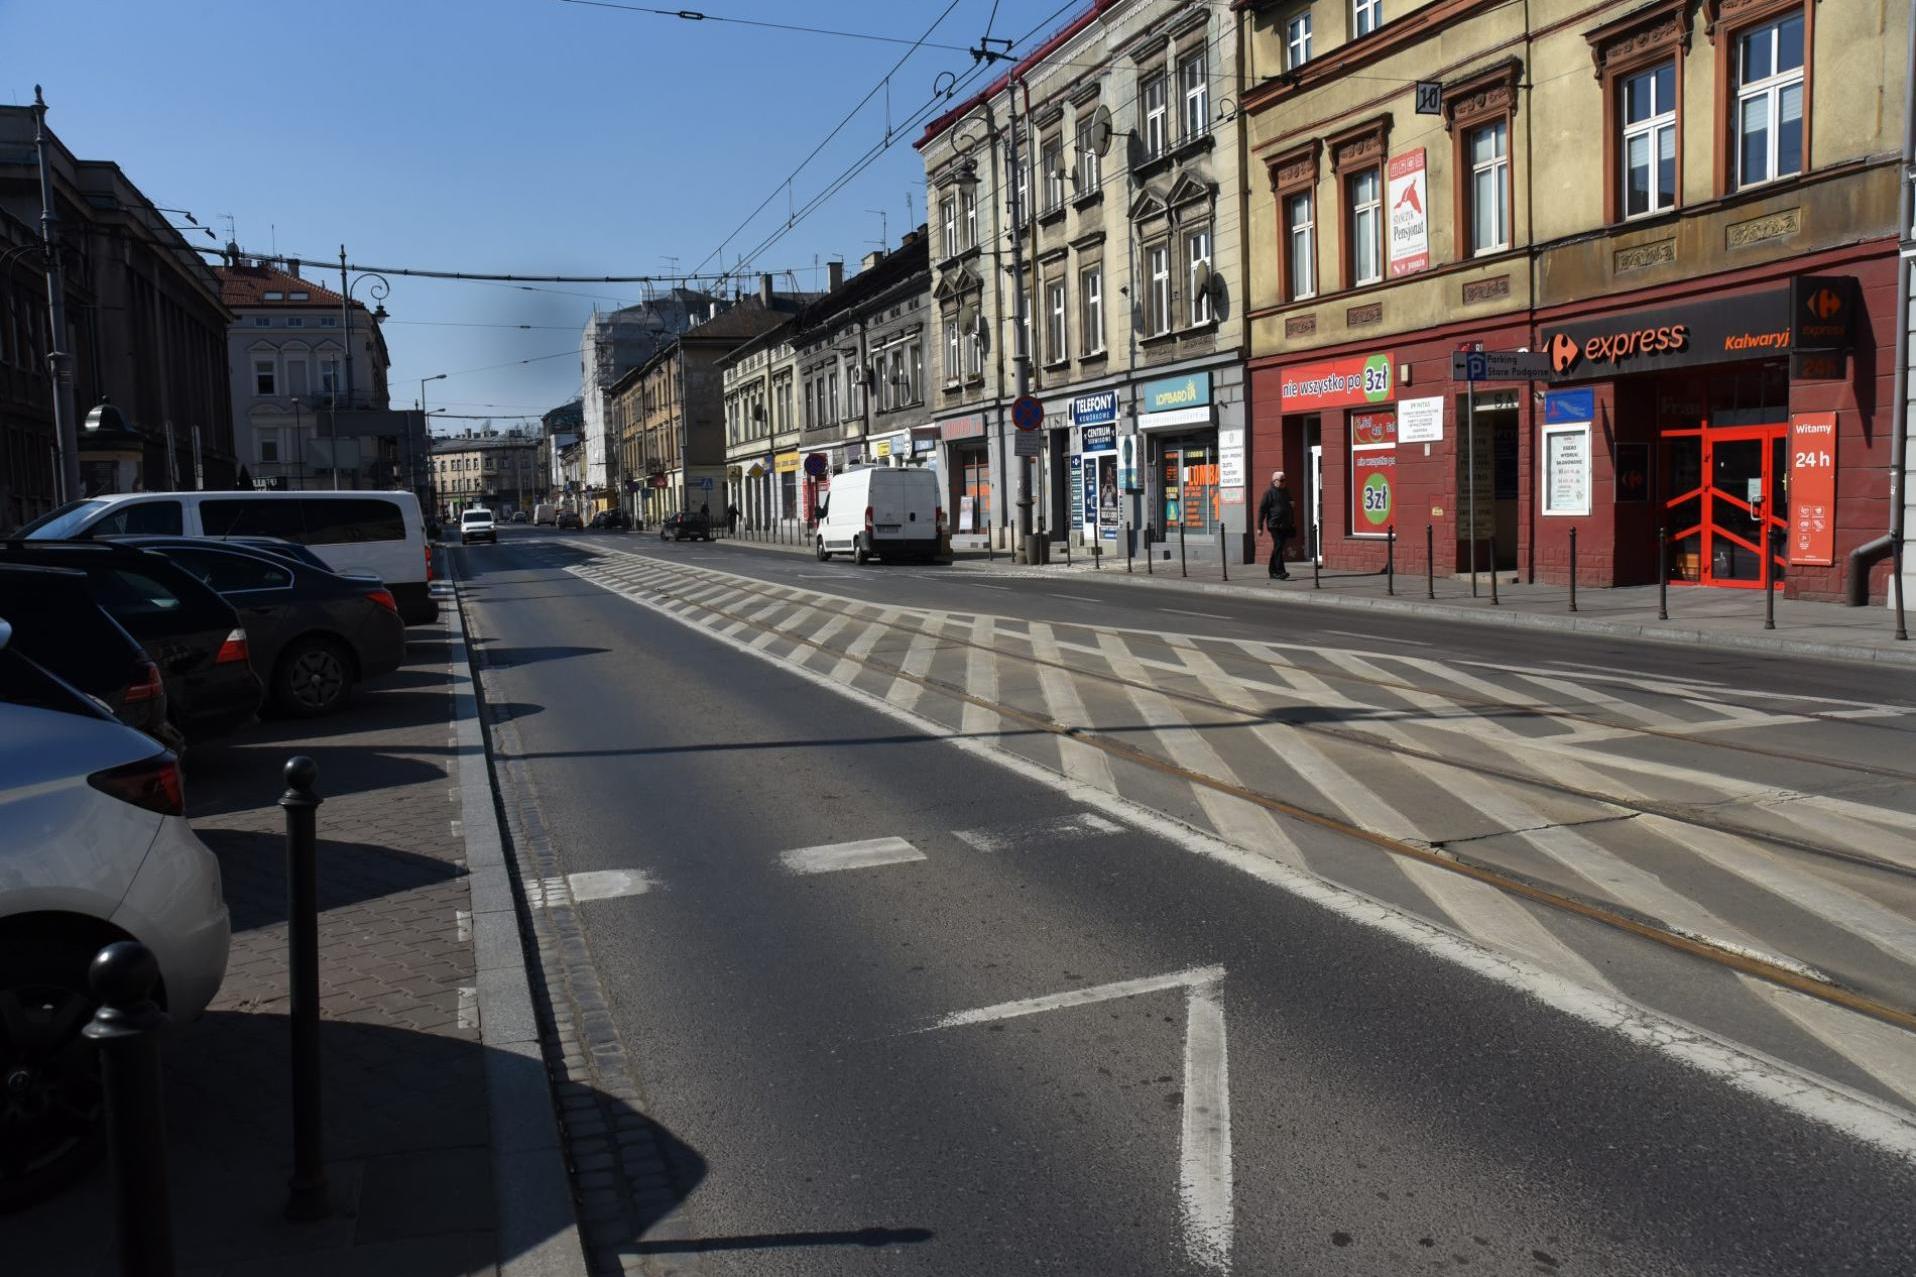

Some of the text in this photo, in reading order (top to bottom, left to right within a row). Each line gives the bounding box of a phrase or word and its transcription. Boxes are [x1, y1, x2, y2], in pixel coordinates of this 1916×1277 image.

[1393, 221, 1424, 241] Pensjonat
[1585, 325, 1686, 364] express
[1724, 328, 1791, 350] Kalwaryj
[1488, 354, 1518, 365] Parking
[1282, 363, 1389, 398] nie wszystko po 3zł
[1488, 367, 1509, 377] Stare
[1076, 394, 1113, 414] TELEFONY
[1087, 426, 1111, 438] CENTRUM
[1795, 424, 1832, 434] Witamy
[1795, 451, 1830, 468] 24 h
[1365, 484, 1388, 511] 3zł
